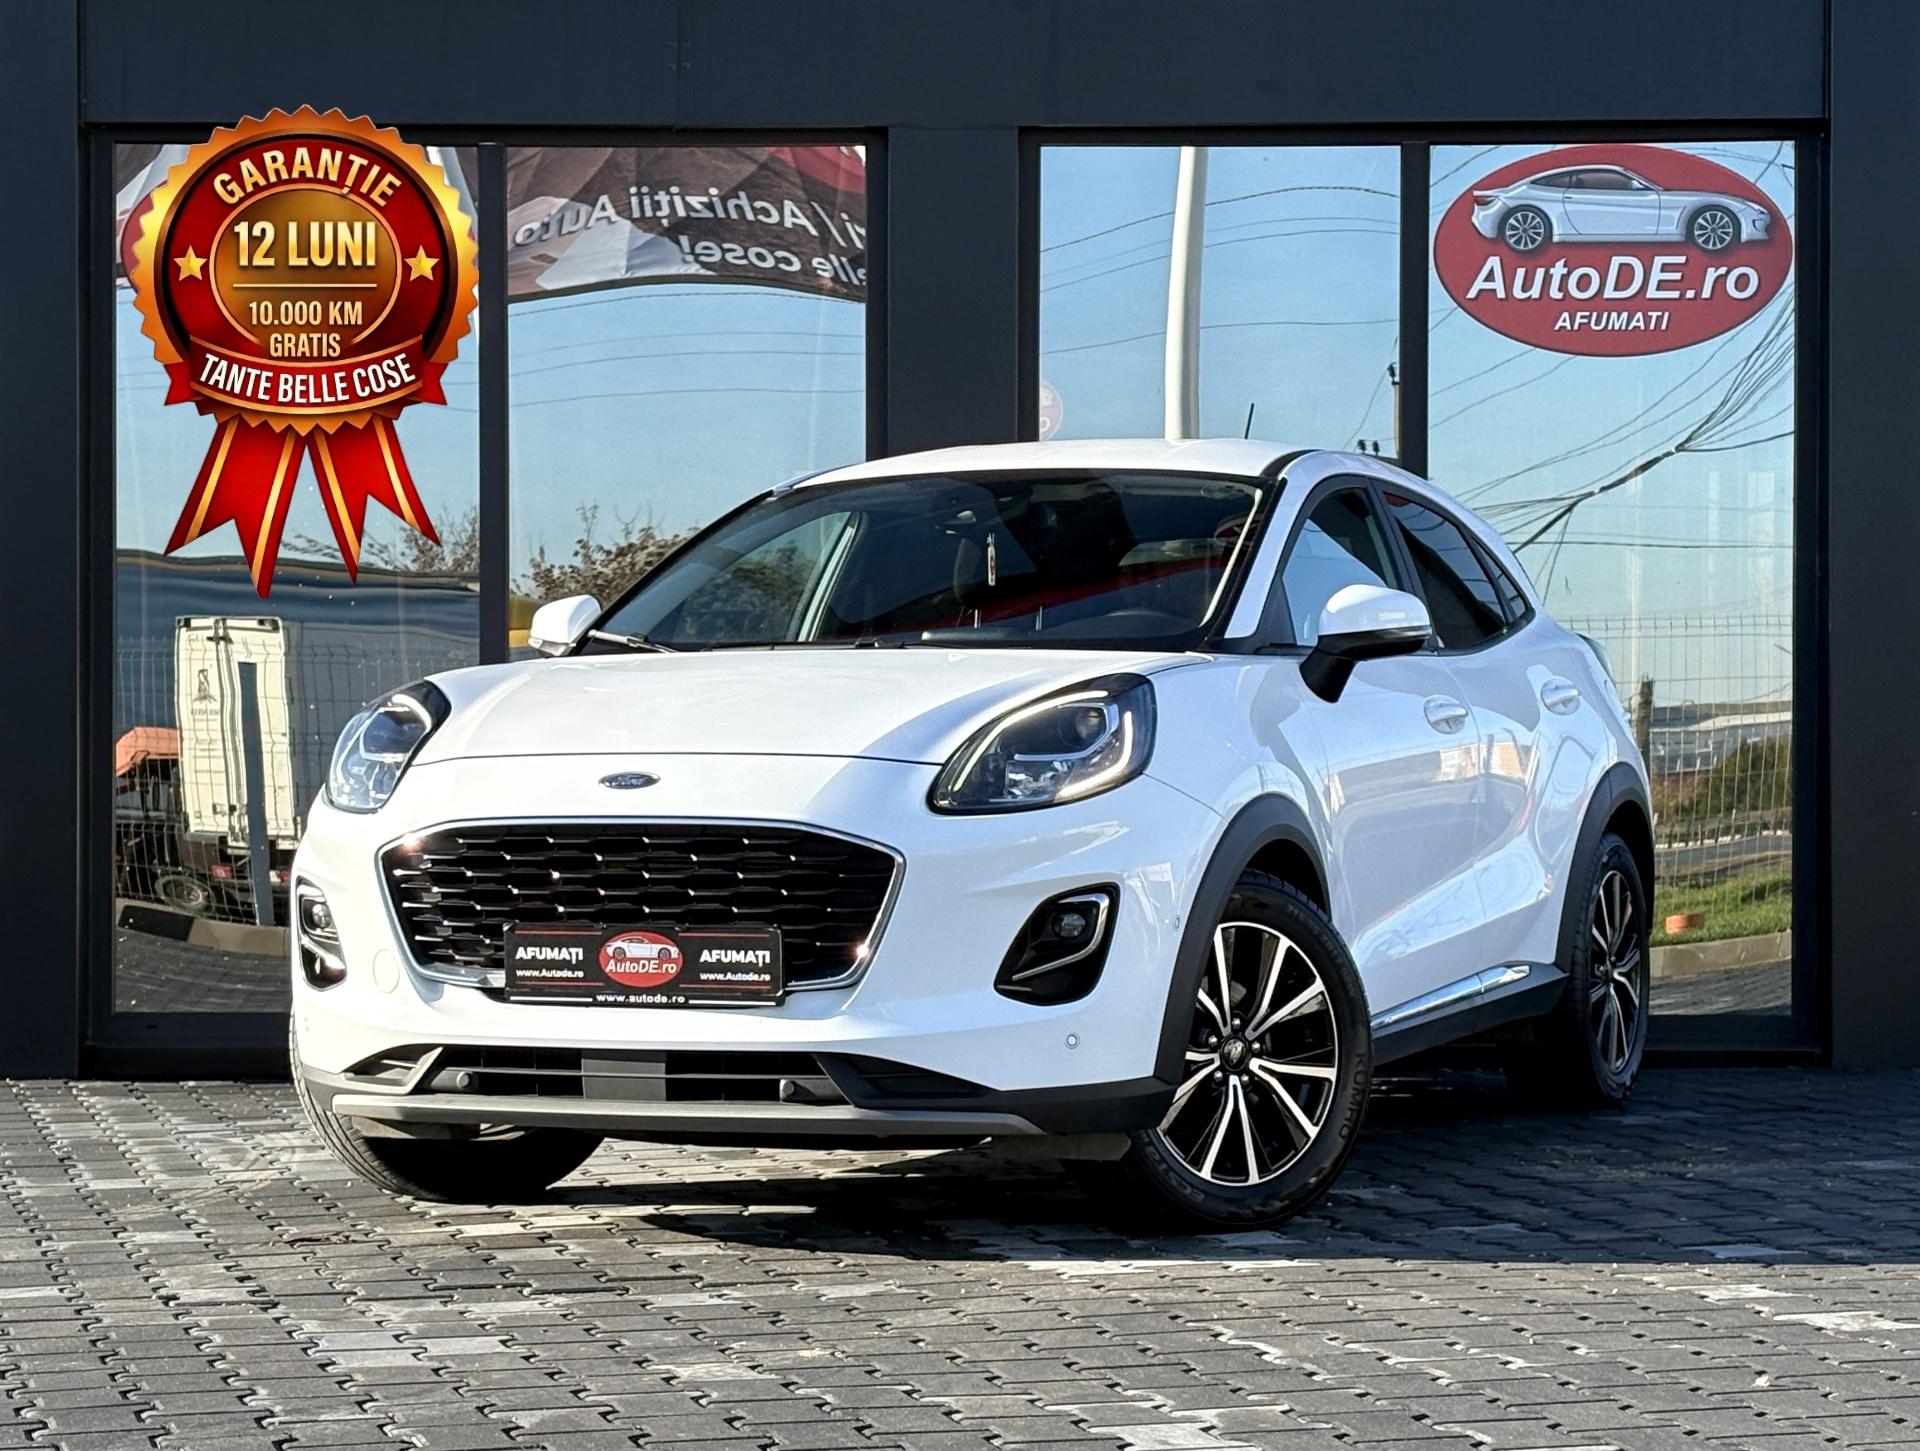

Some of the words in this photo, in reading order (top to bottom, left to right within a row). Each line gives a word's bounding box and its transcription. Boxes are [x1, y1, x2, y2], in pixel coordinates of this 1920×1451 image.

[1466, 255, 1760, 300] AutoDE.ro
[1554, 311, 1670, 331] AFUMATI
[605, 959, 677, 974] AutoDE.ro
[596, 993, 686, 1004] www.autode.ro
